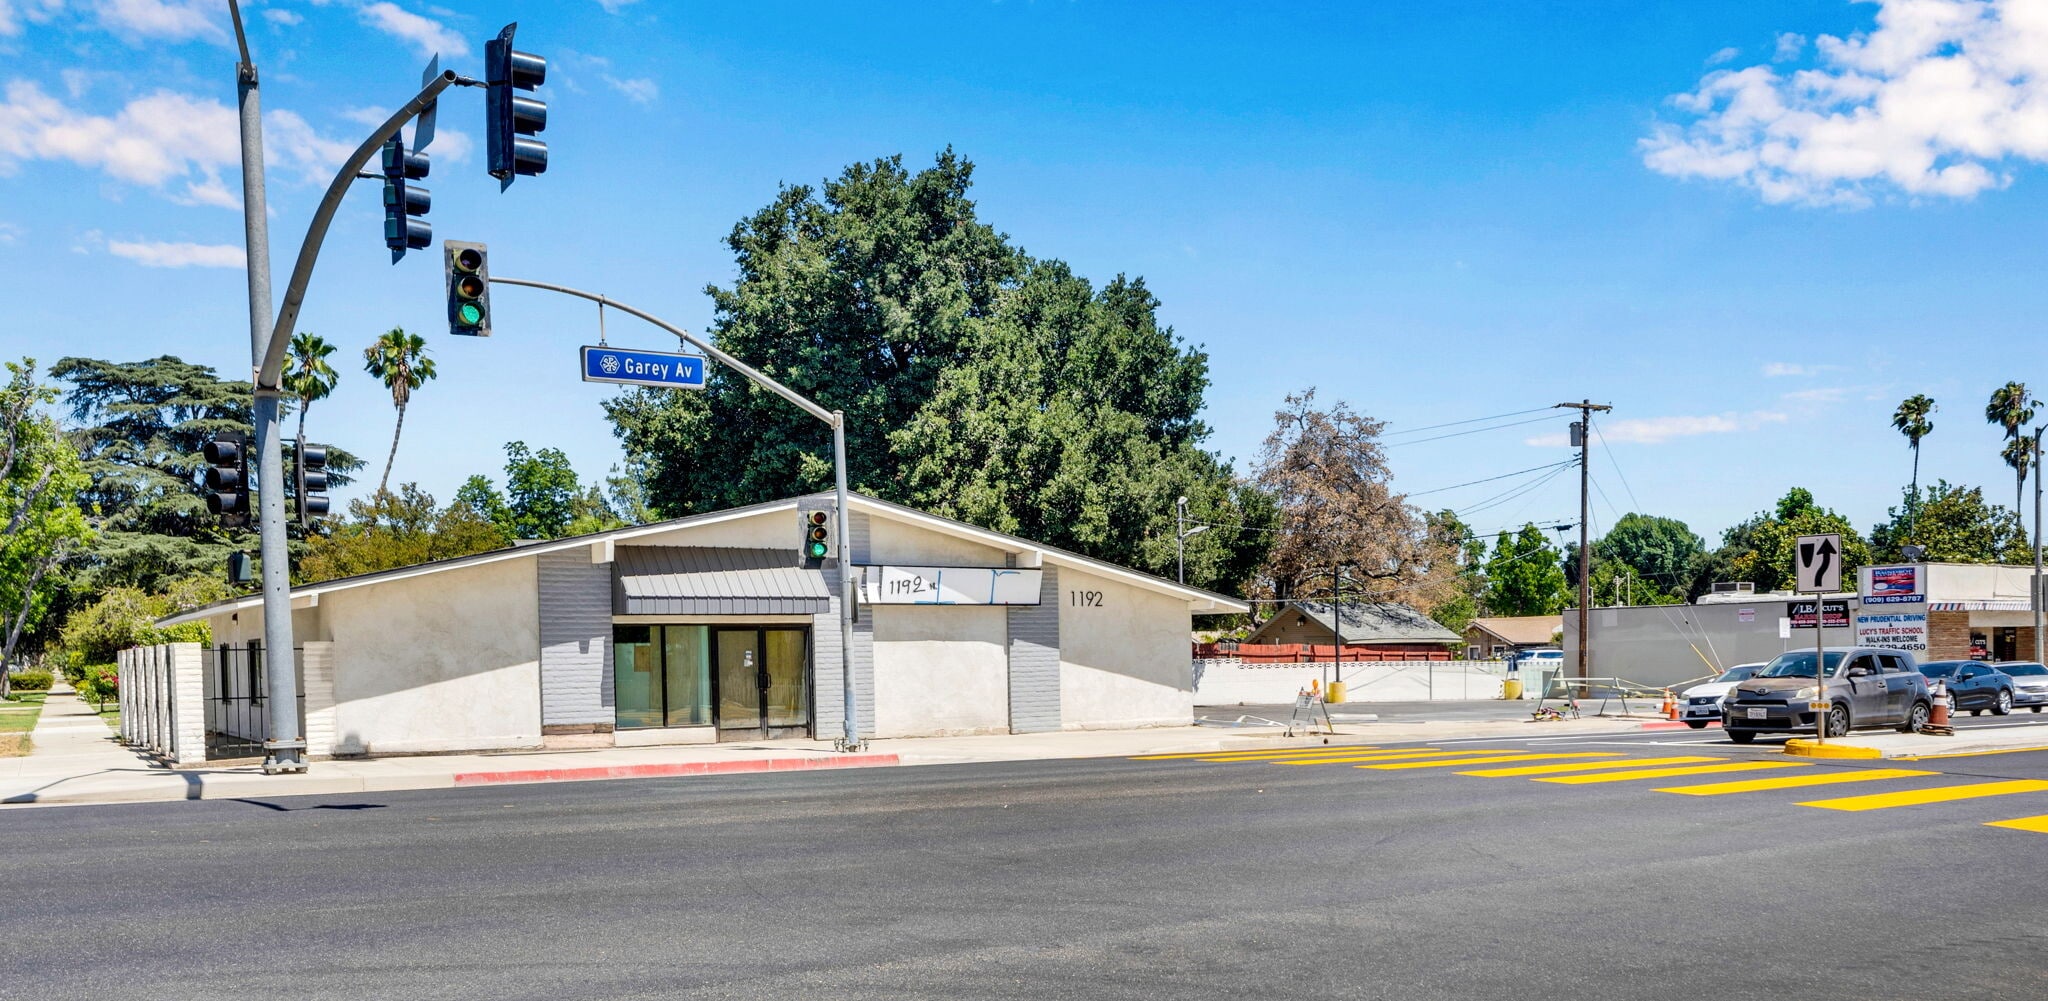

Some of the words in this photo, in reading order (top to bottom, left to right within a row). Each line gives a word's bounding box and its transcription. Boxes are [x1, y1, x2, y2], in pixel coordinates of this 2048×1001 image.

[625, 358, 668, 380] Garey
[675, 362, 693, 378] Av
[890, 576, 926, 595] 1192
[1070, 591, 1103, 607] 1192
[1865, 635, 1890, 643] WALK-INS
[1891, 635, 1918, 643] WELCOME
[1879, 627, 1900, 635] TRAFFIC
